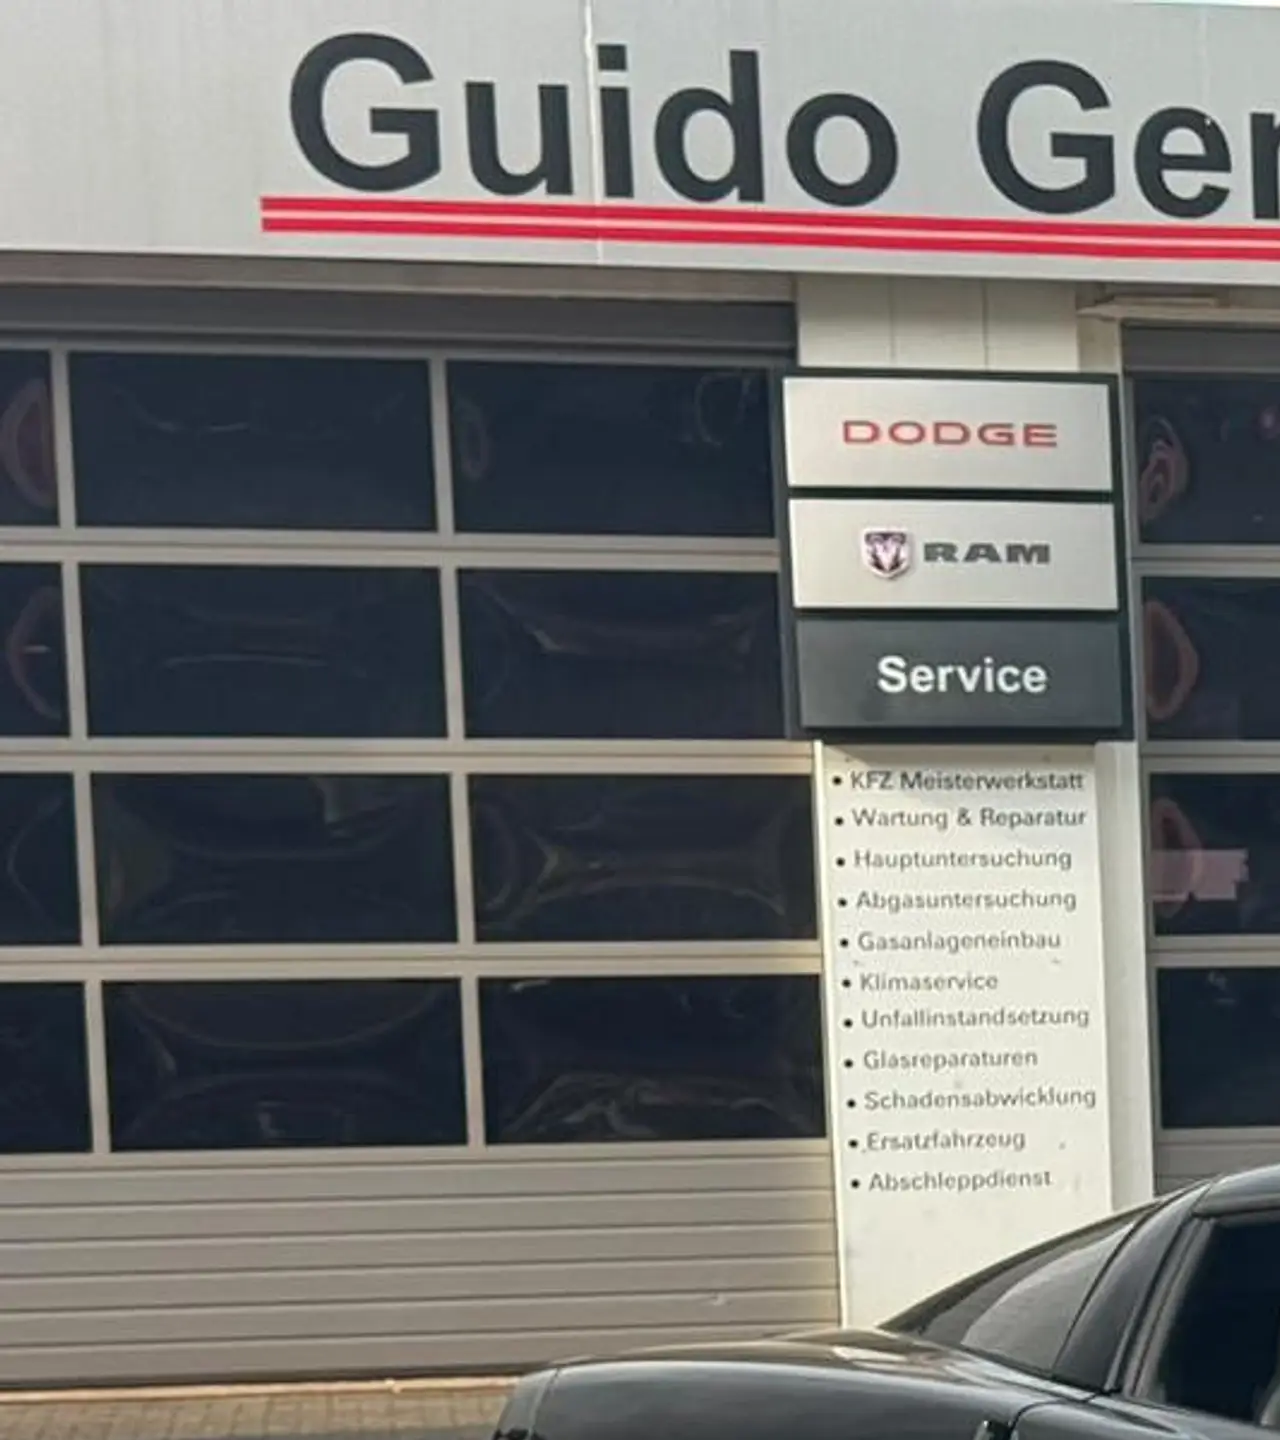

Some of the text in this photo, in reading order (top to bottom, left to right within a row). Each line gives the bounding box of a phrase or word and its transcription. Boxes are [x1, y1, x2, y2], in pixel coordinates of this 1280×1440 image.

[289, 32, 900, 207] Guido
[841, 419, 1058, 448] DODGE
[922, 541, 1052, 565] RAM
[877, 655, 1048, 693] Service
[850, 770, 1086, 791] KFZ Meisterwerkstatt
[851, 807, 1088, 832] Wartung & Reparatur
[853, 848, 1072, 872] Hauptuntersuchung
[855, 889, 1077, 914] Abgasuntersuchung
[857, 930, 1061, 955] Gasanlageneinbau
[859, 971, 999, 992] Klimaservice
[861, 1006, 1090, 1029] Unfallinstandsetzung
[863, 1050, 1038, 1073] Glasreparaturen
[864, 1084, 1097, 1112] Schadensabwicklung
[867, 1129, 1027, 1153] Ersatzfahrzeug
[868, 1169, 1052, 1194] Abschleppdienst
